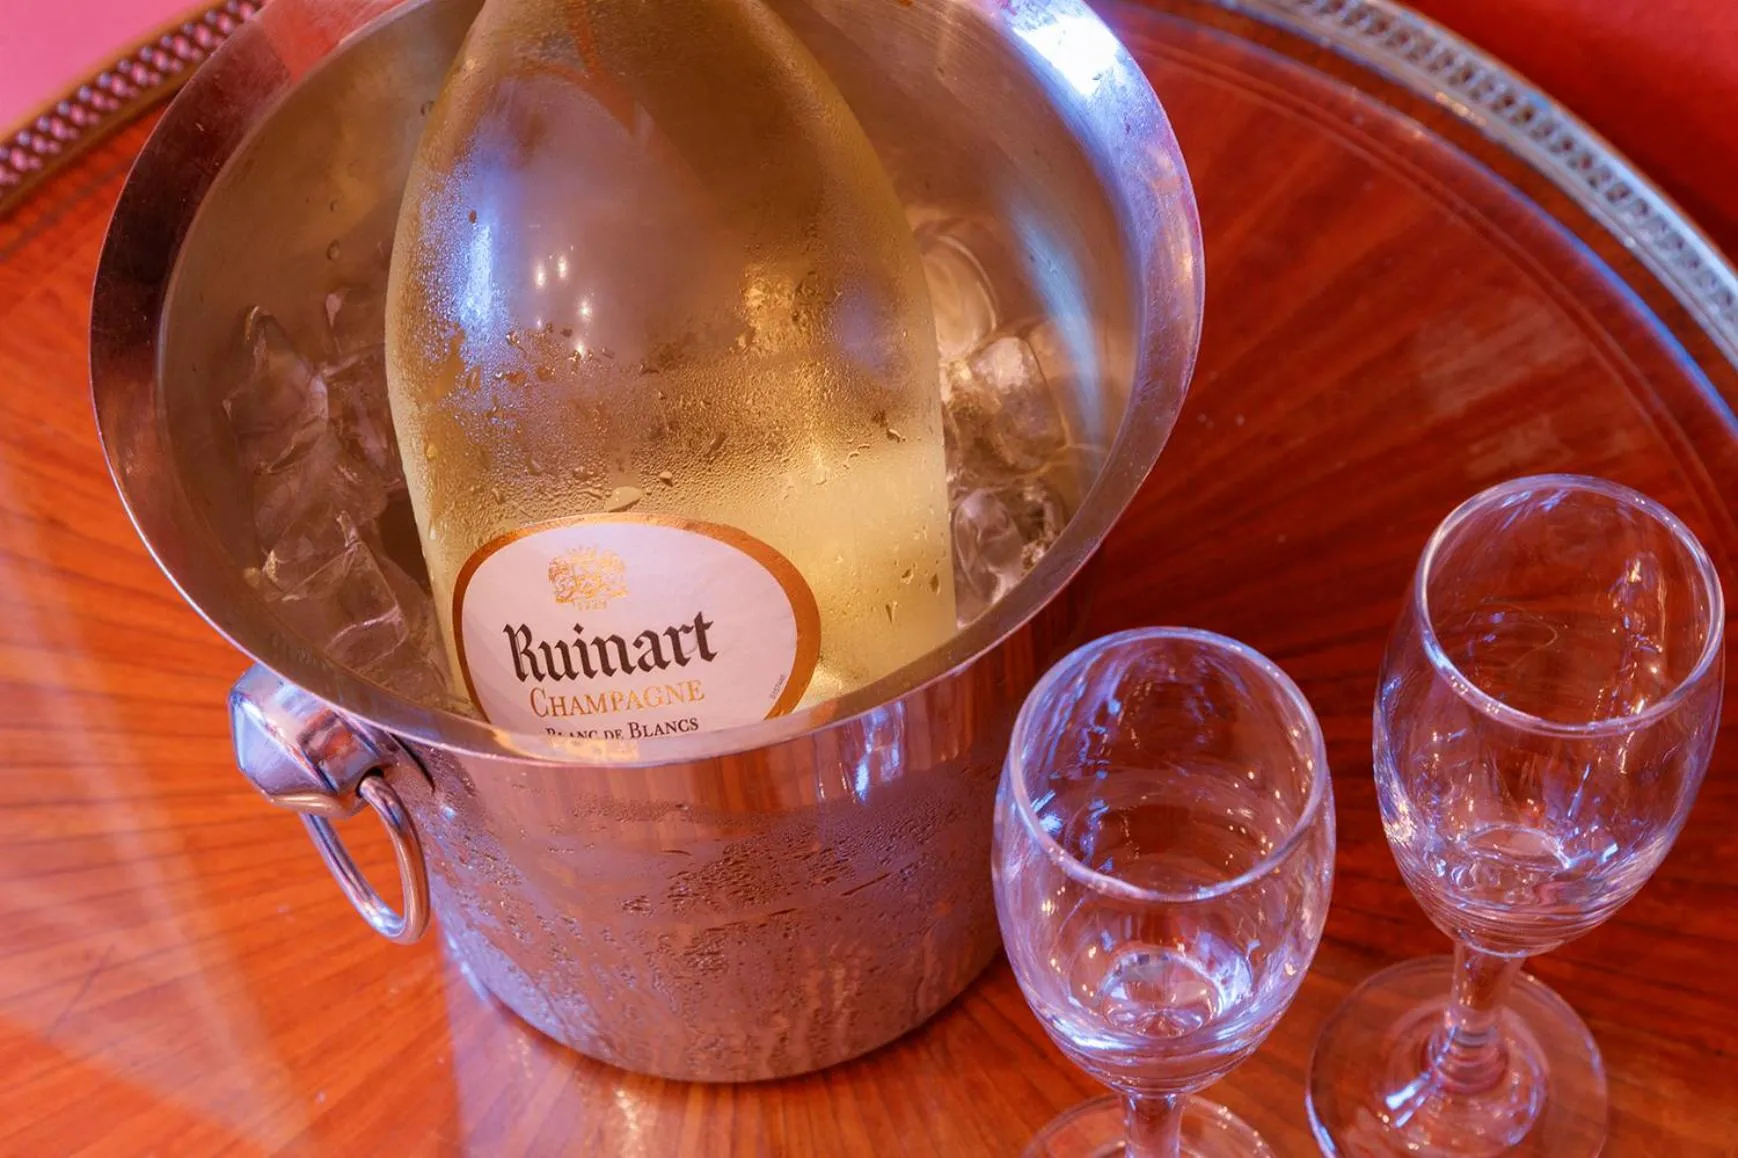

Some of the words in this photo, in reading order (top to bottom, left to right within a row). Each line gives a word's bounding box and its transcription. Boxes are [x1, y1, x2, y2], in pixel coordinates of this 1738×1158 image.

[503, 611, 718, 682] Ruinart
[530, 680, 705, 718] CHAMPAGNE
[628, 717, 699, 739] BLANCS
